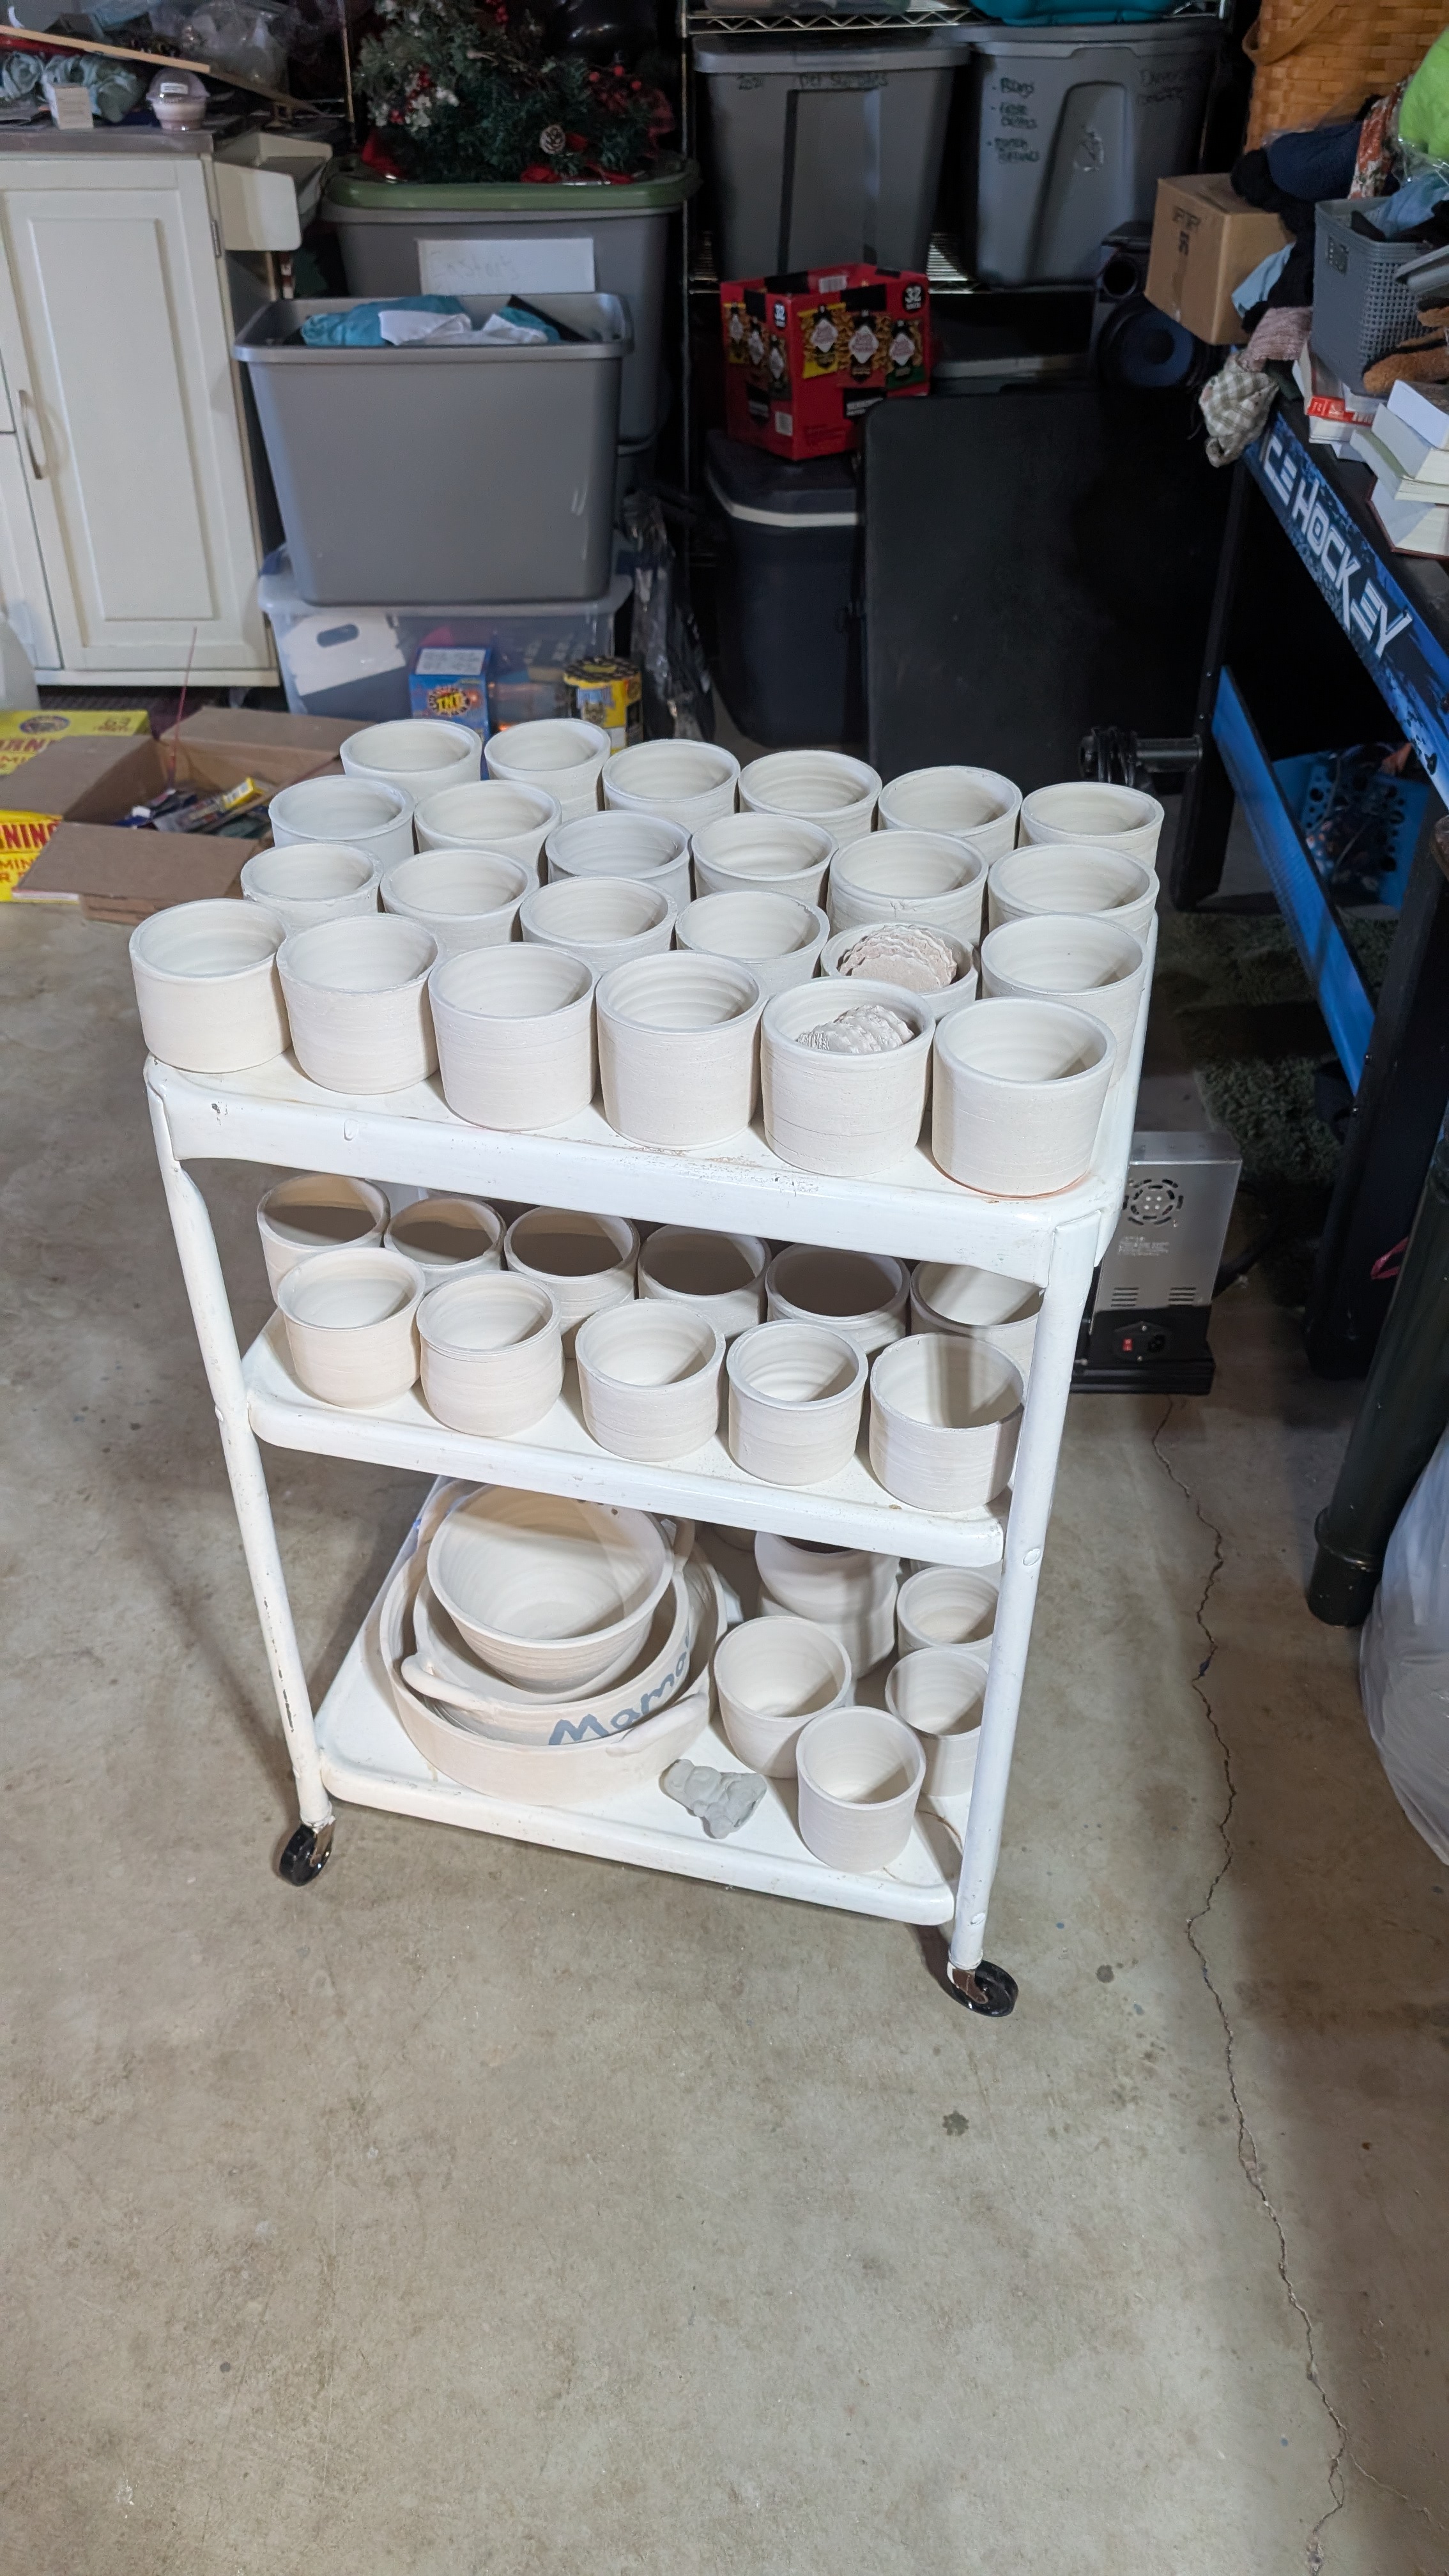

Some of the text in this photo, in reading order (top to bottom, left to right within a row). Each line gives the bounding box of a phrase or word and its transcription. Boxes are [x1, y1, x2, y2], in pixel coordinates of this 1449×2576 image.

[905, 286, 921, 303] 32
[1292, 479, 1413, 658] HOCKEY
[436, 692, 463, 711] TNT
